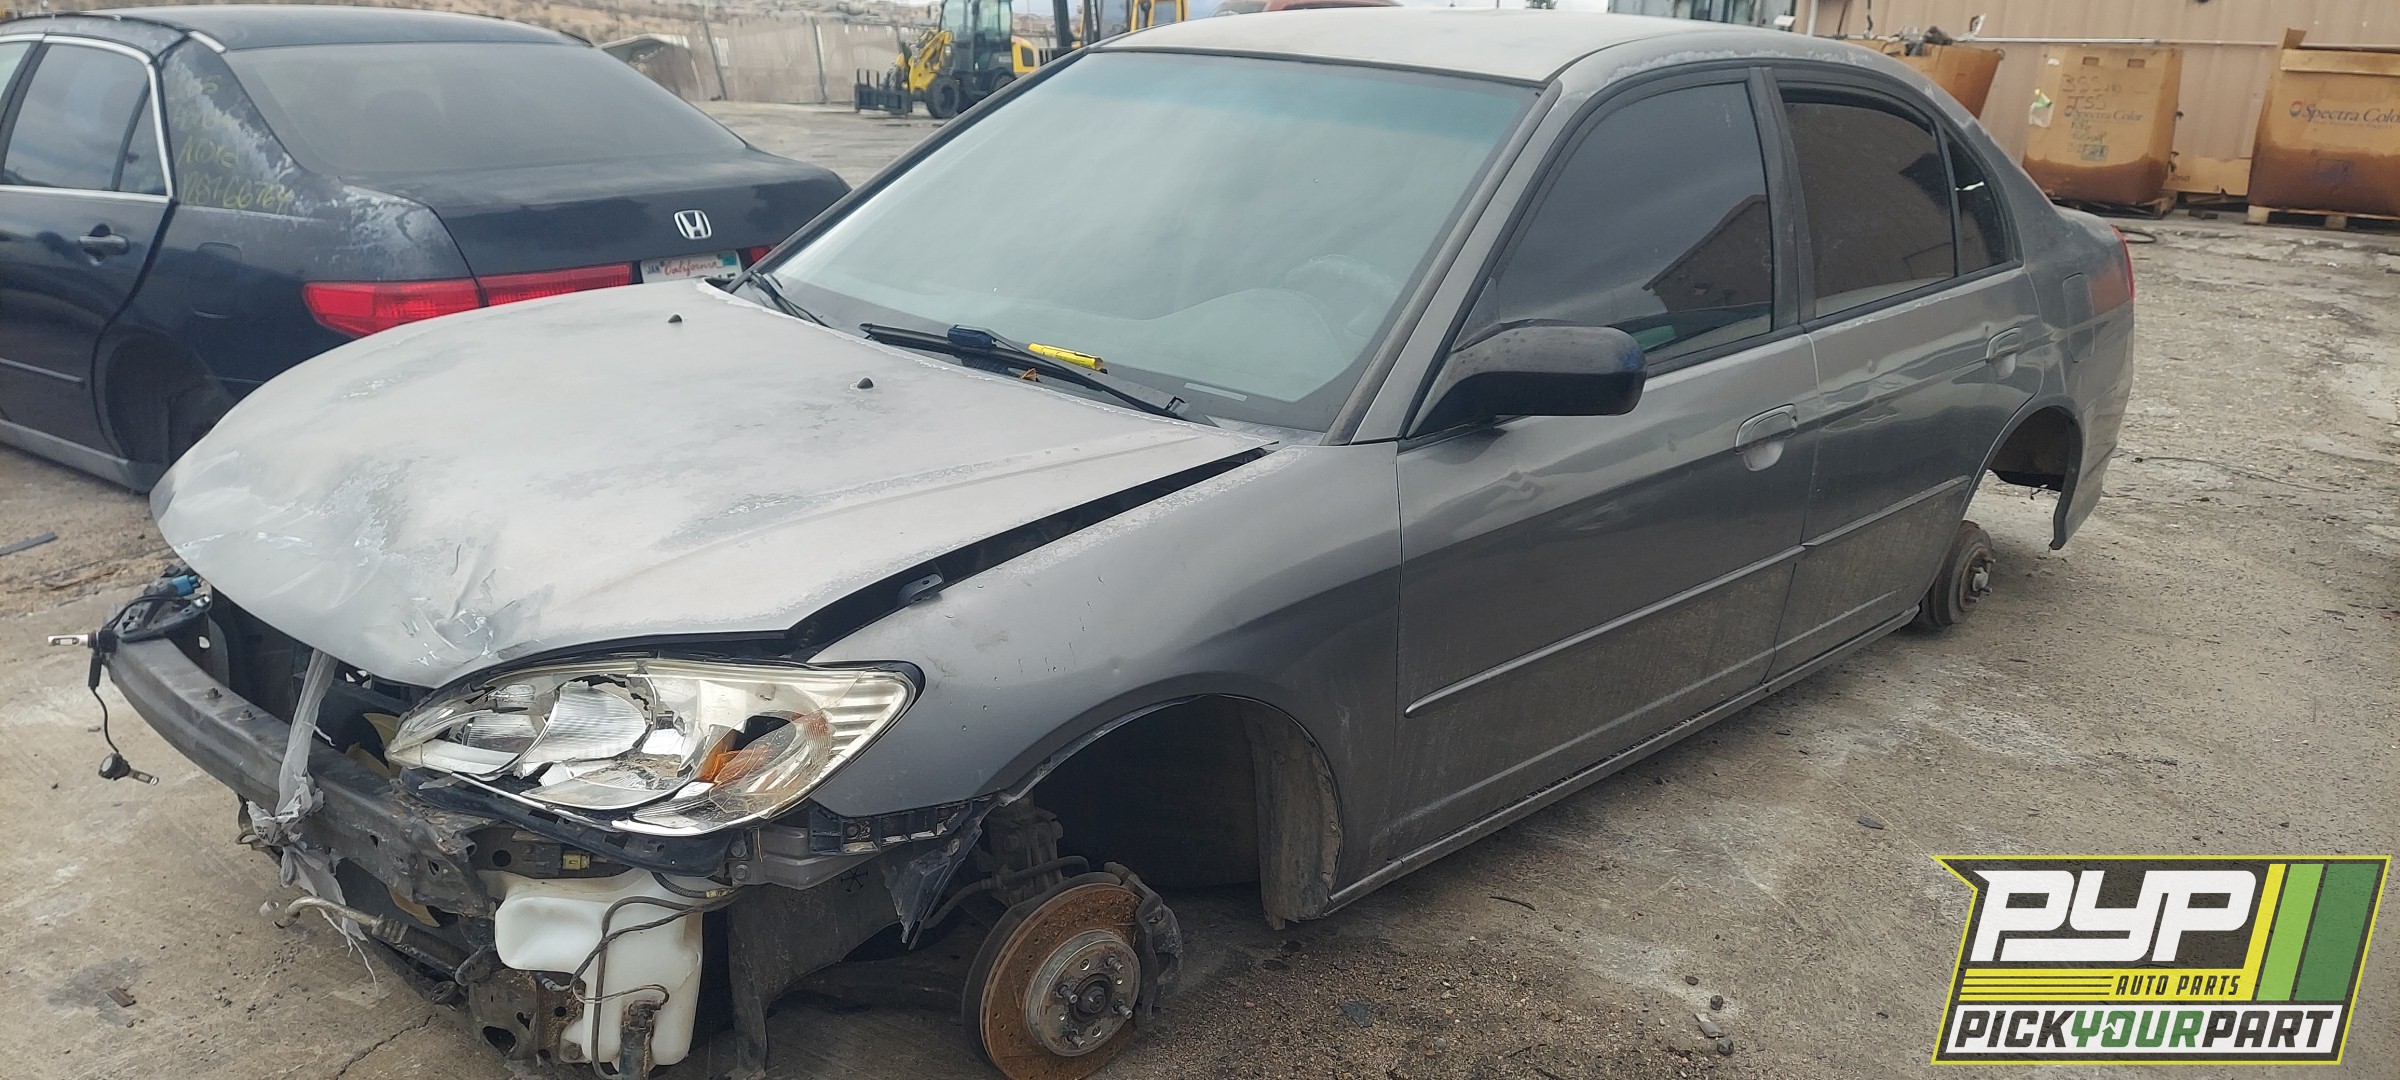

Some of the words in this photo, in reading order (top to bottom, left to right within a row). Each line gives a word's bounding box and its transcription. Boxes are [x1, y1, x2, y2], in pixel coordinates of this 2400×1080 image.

[2112, 110, 2143, 121] Color
[2302, 103, 2360, 122] Spectra
[664, 261, 722, 276] California
